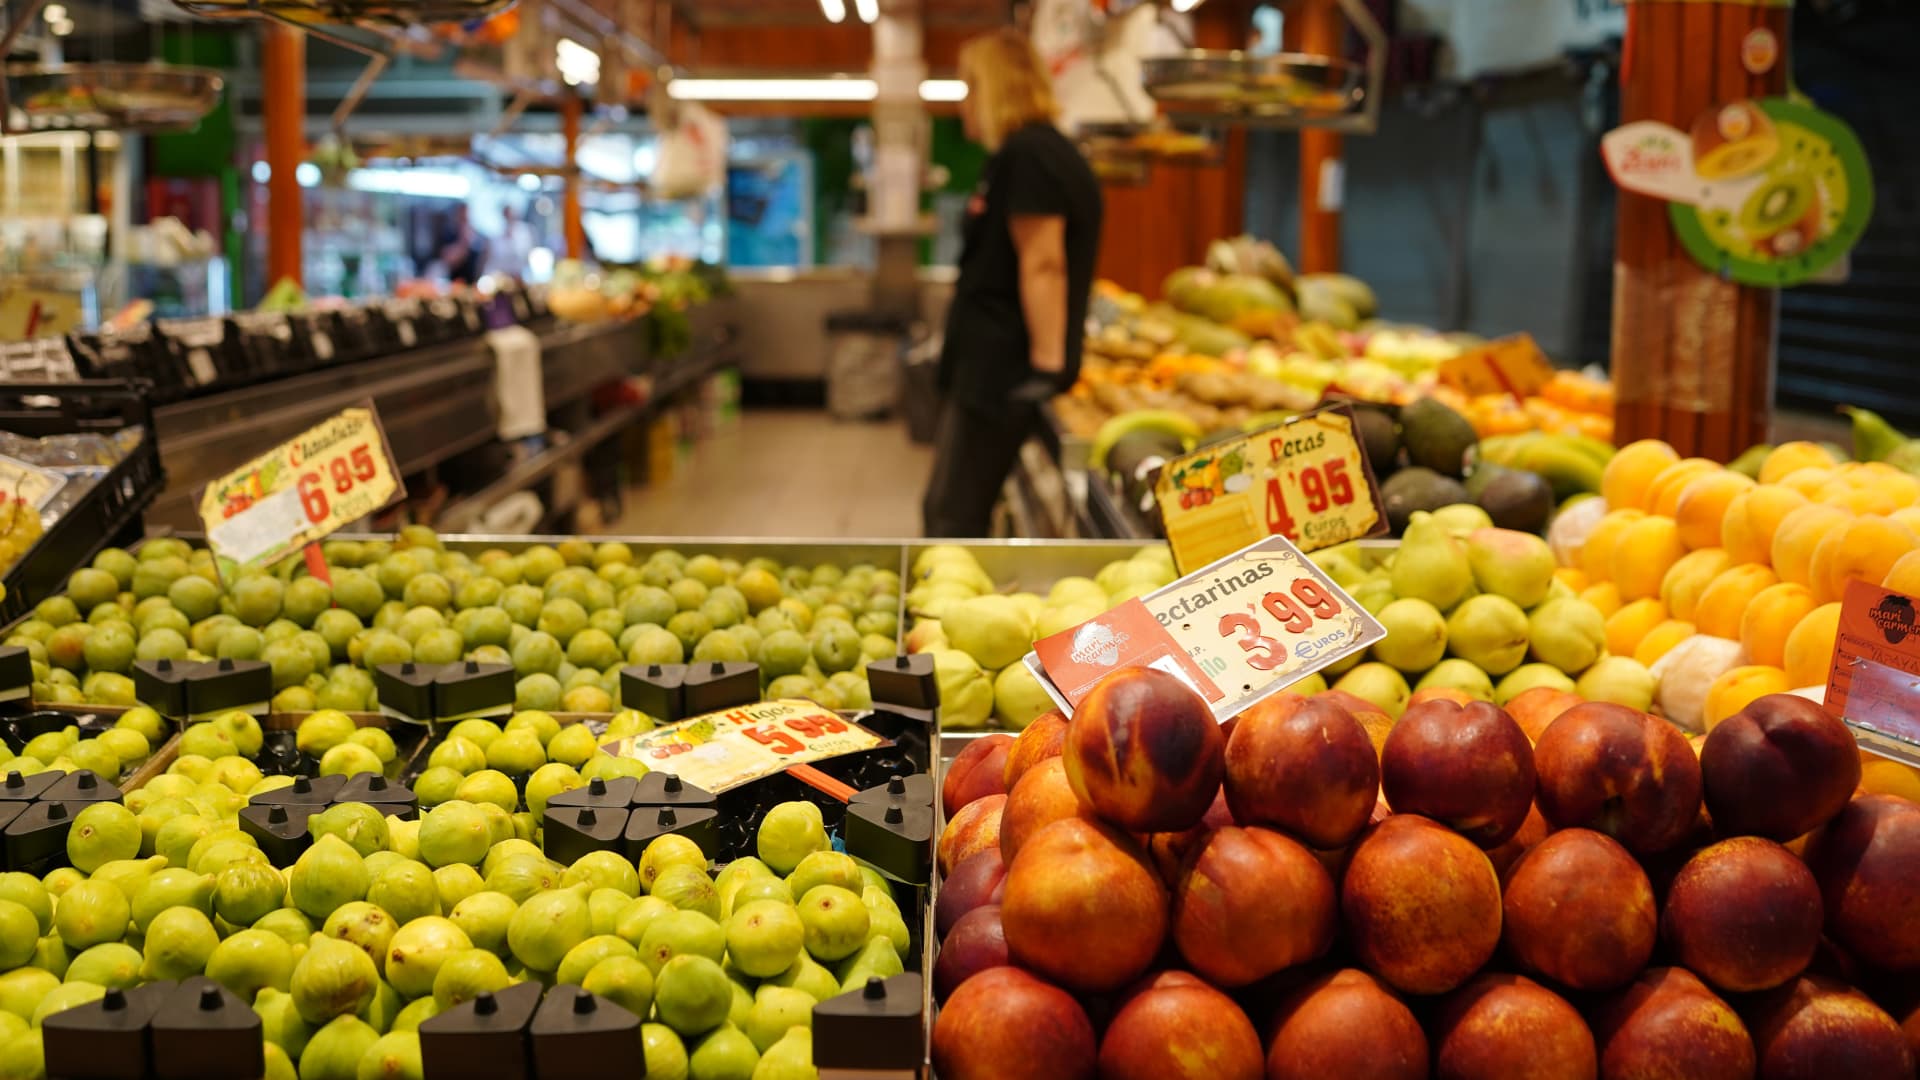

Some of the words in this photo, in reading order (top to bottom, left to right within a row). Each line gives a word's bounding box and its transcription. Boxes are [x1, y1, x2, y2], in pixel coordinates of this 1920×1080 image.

[1269, 432, 1325, 462] Peras
[1155, 562, 1274, 627] ectarinas
[1199, 656, 1228, 679] ilo
[725, 706, 795, 725] Higos
